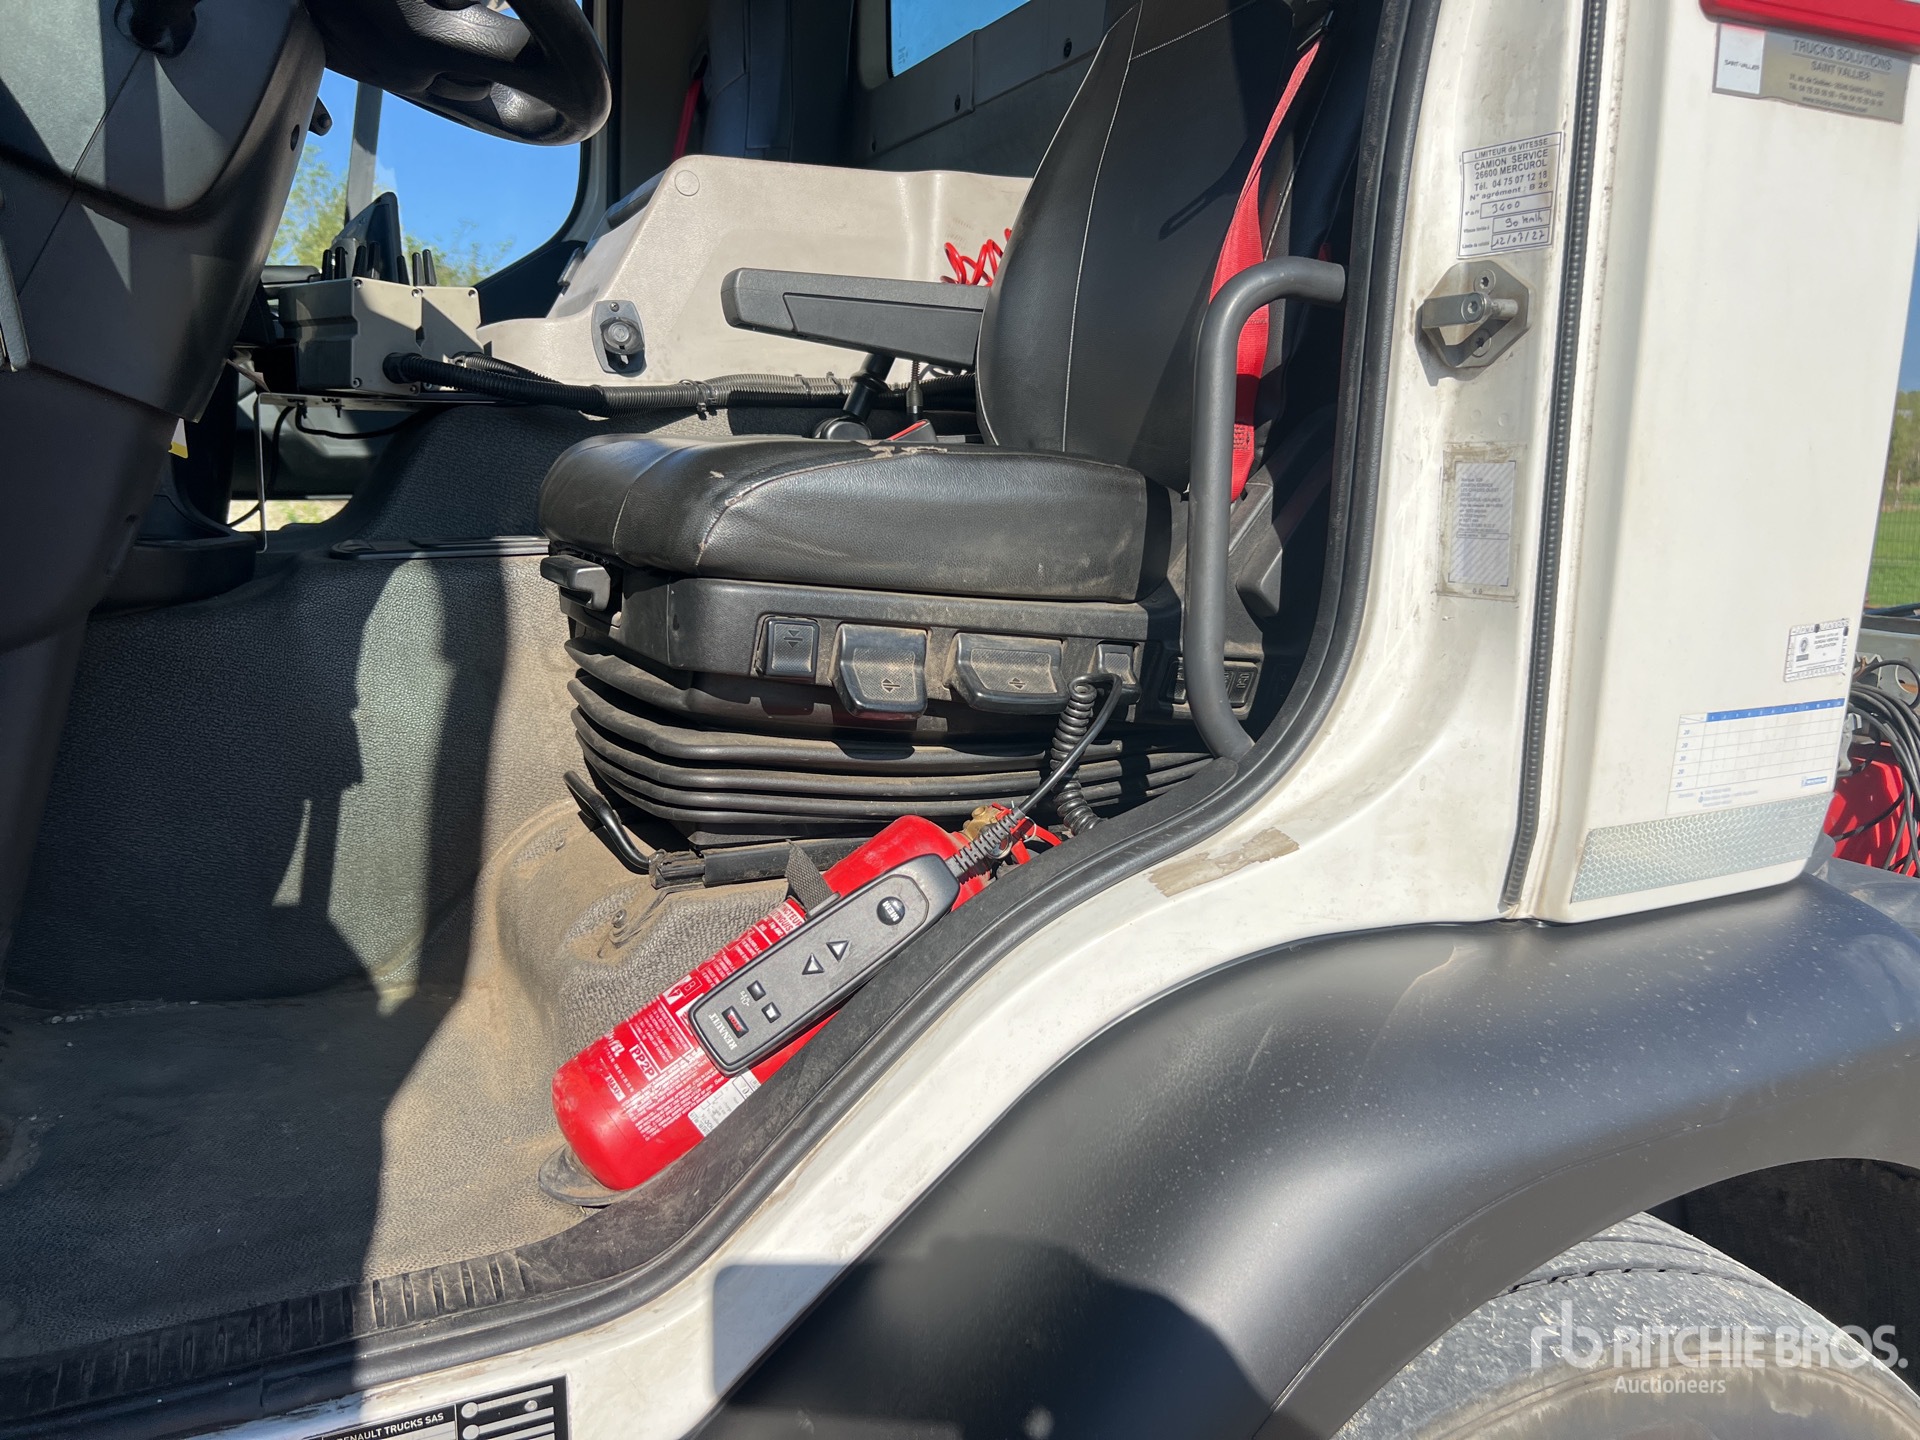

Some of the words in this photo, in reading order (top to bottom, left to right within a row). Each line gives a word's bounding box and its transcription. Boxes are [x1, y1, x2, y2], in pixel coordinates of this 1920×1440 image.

[1793, 40, 1835, 58] TRUCKS
[1836, 47, 1893, 70] SOLUTIONS
[1474, 157, 1507, 170] CAMION
[1512, 148, 1549, 164] SERVICE
[1475, 146, 1507, 159] LIMITEUR
[1508, 145, 1516, 154] de
[1518, 138, 1549, 150] VITESSE
[1474, 182, 1488, 191] Tél.
[1492, 179, 1502, 188] 04
[1504, 177, 1513, 186] 75
[1514, 175, 1524, 184] 07
[1528, 172, 1536, 182] 12
[1539, 170, 1548, 180] 18
[1475, 168, 1498, 180] 26600
[1500, 159, 1548, 175] MERCUROL
[1481, 187, 1521, 200] agrément
[882, 900, 900, 922] MEM
[708, 1012, 738, 1051] RENAULT
[631, 1046, 656, 1077] PP2P
[336, 1428, 382, 1440] NAULT
[384, 1418, 423, 1436] TRUCKS
[425, 1412, 444, 1425] SAS
